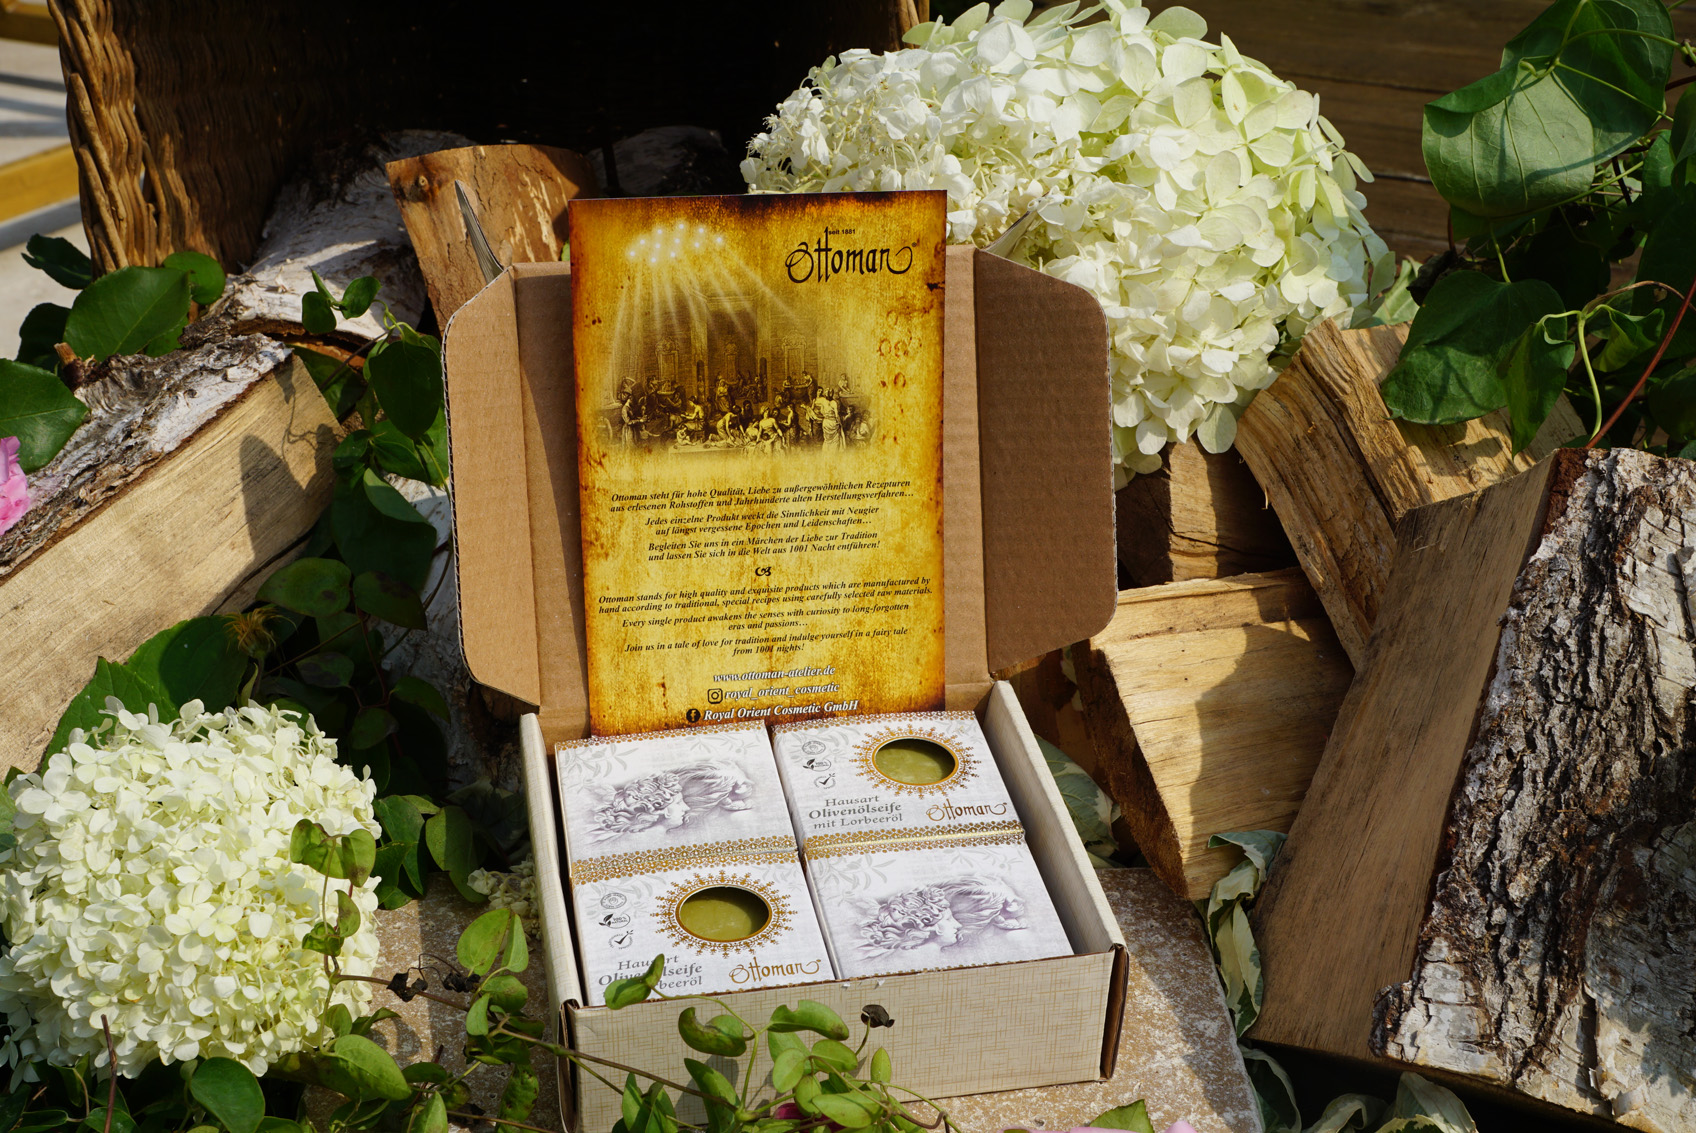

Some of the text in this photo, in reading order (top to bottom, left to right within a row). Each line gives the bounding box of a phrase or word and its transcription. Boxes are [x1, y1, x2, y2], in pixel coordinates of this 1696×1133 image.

[785, 226, 912, 283] Ottoman
[612, 494, 647, 502] Ottoman
[650, 492, 669, 500] steht
[670, 491, 684, 500] für
[687, 490, 707, 498] hohe
[748, 486, 770, 495] Liebe
[784, 482, 863, 494] außergewöhnlichen
[866, 480, 910, 489] Rezepturen
[628, 503, 666, 512] erlesenen
[669, 499, 714, 510] Rohstoffen
[716, 498, 732, 506] und
[734, 494, 790, 506] Jahrhunderte
[792, 494, 812, 502] alten
[645, 518, 668, 526] Jedes
[670, 516, 704, 524] einzelne
[706, 514, 739, 522] Produkt
[742, 512, 764, 520] weckt
[766, 511, 778, 519] die
[780, 508, 830, 518] Sinnlichkeit
[847, 506, 879, 515] Neugier
[656, 526, 670, 536] auf
[672, 526, 697, 536] längst
[700, 524, 742, 534] vergessene
[745, 520, 780, 530] Epochen
[784, 520, 799, 528] und
[648, 542, 686, 552] Begleiten
[688, 541, 702, 549] Sie
[746, 534, 783, 544] Märchen
[786, 535, 799, 544] der
[801, 534, 823, 542] Liebe
[842, 532, 878, 540] Tradition
[648, 552, 664, 560] und
[666, 551, 692, 560] lassen
[694, 550, 706, 558] Sie
[709, 549, 725, 557] sich
[738, 547, 750, 555] die
[753, 546, 770, 554] Welt
[790, 544, 808, 552] 1001
[811, 543, 835, 552] Nacht
[837, 540, 880, 550] entführen!
[598, 596, 634, 604] Ottoman
[636, 592, 662, 601] stands
[664, 591, 676, 602] for
[679, 590, 698, 600] high
[700, 588, 728, 599] quality
[730, 587, 746, 595] and
[748, 586, 783, 594] exquisite
[785, 583, 820, 594] products
[822, 580, 846, 590] which
[864, 578, 919, 588] manufactured
[922, 577, 930, 586] by
[598, 605, 620, 614] hand
[622, 602, 662, 612] according
[675, 599, 720, 608] traditional,
[722, 596, 750, 607] special
[752, 596, 780, 604] recipes
[782, 594, 804, 602] using
[806, 590, 842, 600] carefully
[844, 589, 874, 598] selected
[894, 586, 932, 595] materials.
[622, 619, 645, 628] Every
[648, 617, 672, 626] single
[674, 615, 706, 625] product
[708, 613, 742, 622] awakens
[787, 608, 804, 616] with
[806, 606, 840, 616] curiosity
[852, 604, 908, 614] long-forgotten
[748, 622, 762, 630] and
[624, 644, 642, 652] Join
[674, 640, 689, 648] tale
[692, 640, 702, 649] of
[702, 639, 718, 647] love
[720, 638, 732, 648] for
[735, 636, 769, 645] tradition
[772, 634, 786, 642] and
[789, 632, 820, 642] indulge
[821, 630, 854, 641] yourself
[872, 628, 892, 638] fairy
[732, 643, 804, 656] from 1001 nights!
[713, 665, 836, 682] www.ottoman-atelier.de
[725, 682, 840, 700] royal_orient_cosmetic
[704, 700, 858, 722] Royal Orient Cosmetic GmbH
[825, 795, 879, 806] Hausart
[926, 798, 1007, 822] Ottoman
[809, 802, 901, 820] Olivenölseife
[814, 813, 902, 830] mit Lorbeeröl
[618, 955, 679, 970] Haurt
[729, 956, 820, 984] Ottoman
[657, 976, 702, 990] beeröl
